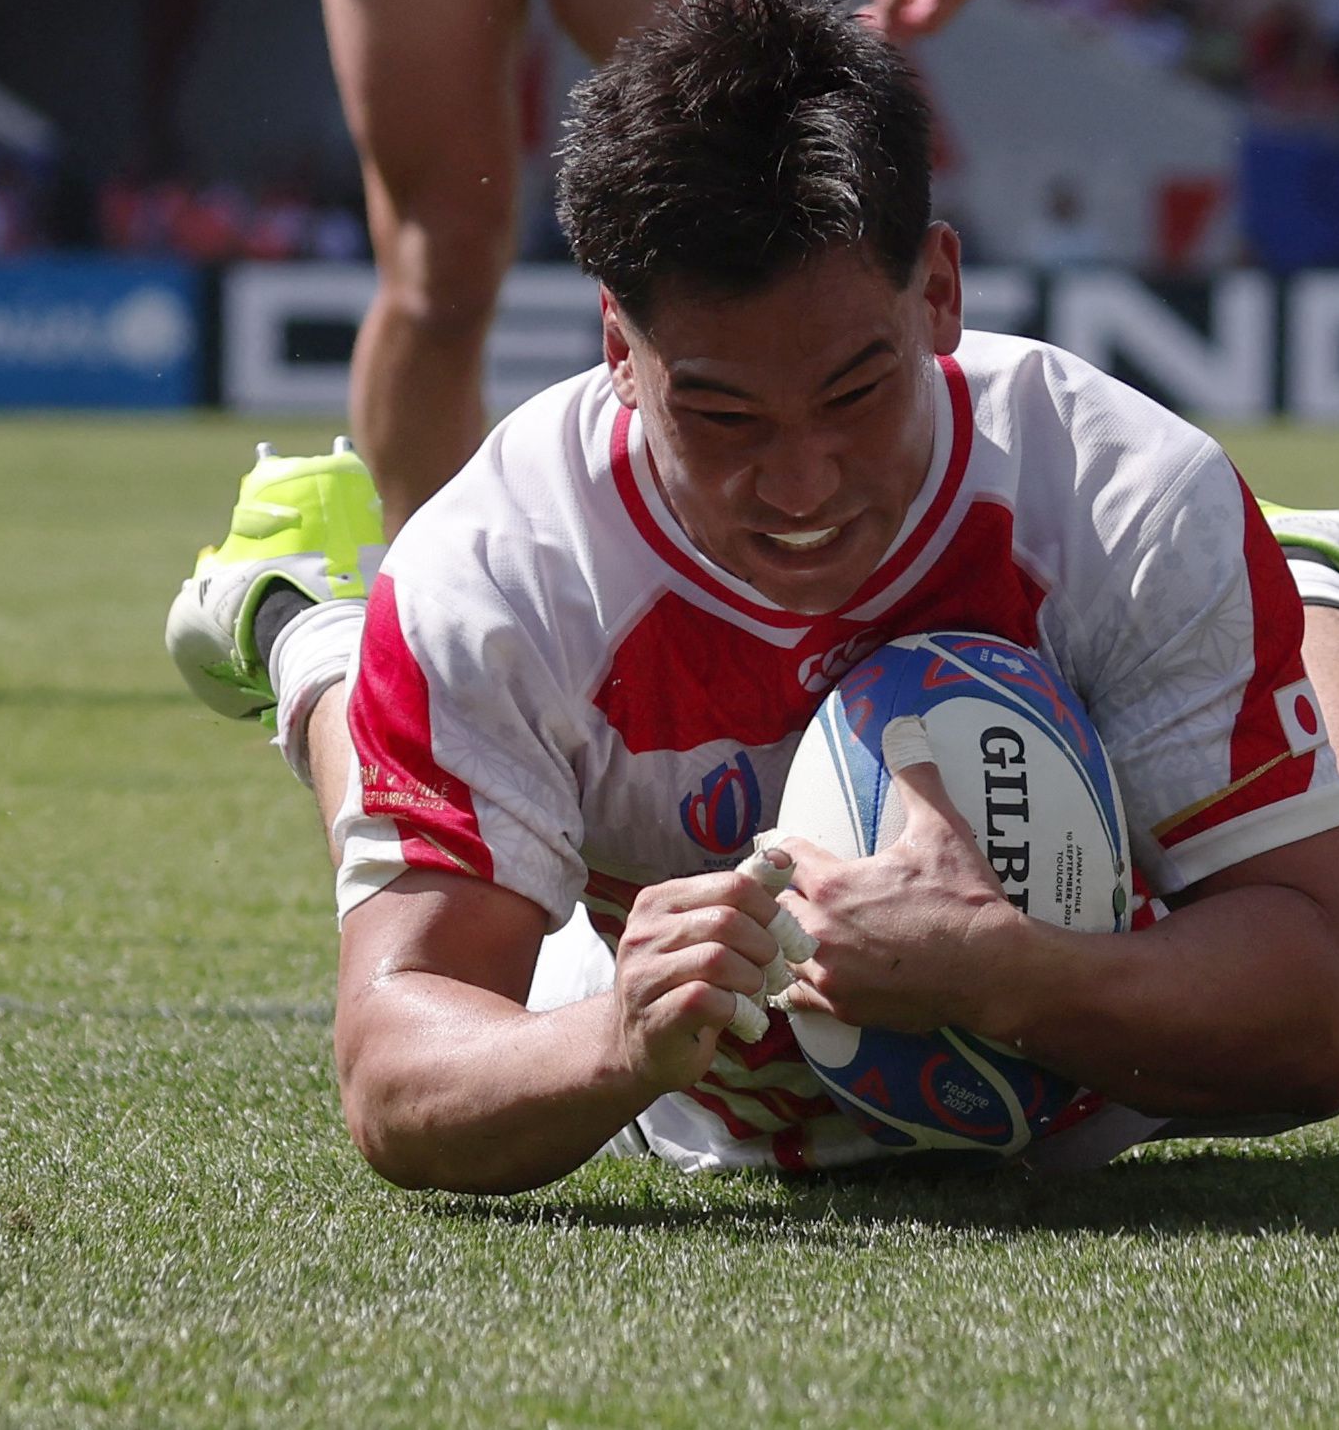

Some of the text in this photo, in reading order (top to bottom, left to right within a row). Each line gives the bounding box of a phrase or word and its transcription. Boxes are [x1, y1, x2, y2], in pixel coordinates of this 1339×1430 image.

[1066, 830, 1074, 841] 10
[1075, 845, 1083, 877] JAPAN
[1055, 851, 1064, 904] TOULOUSE
[1074, 885, 1083, 914] CHILE
[1064, 904, 1072, 926] 2023
[943, 1094, 974, 1115] 2023
